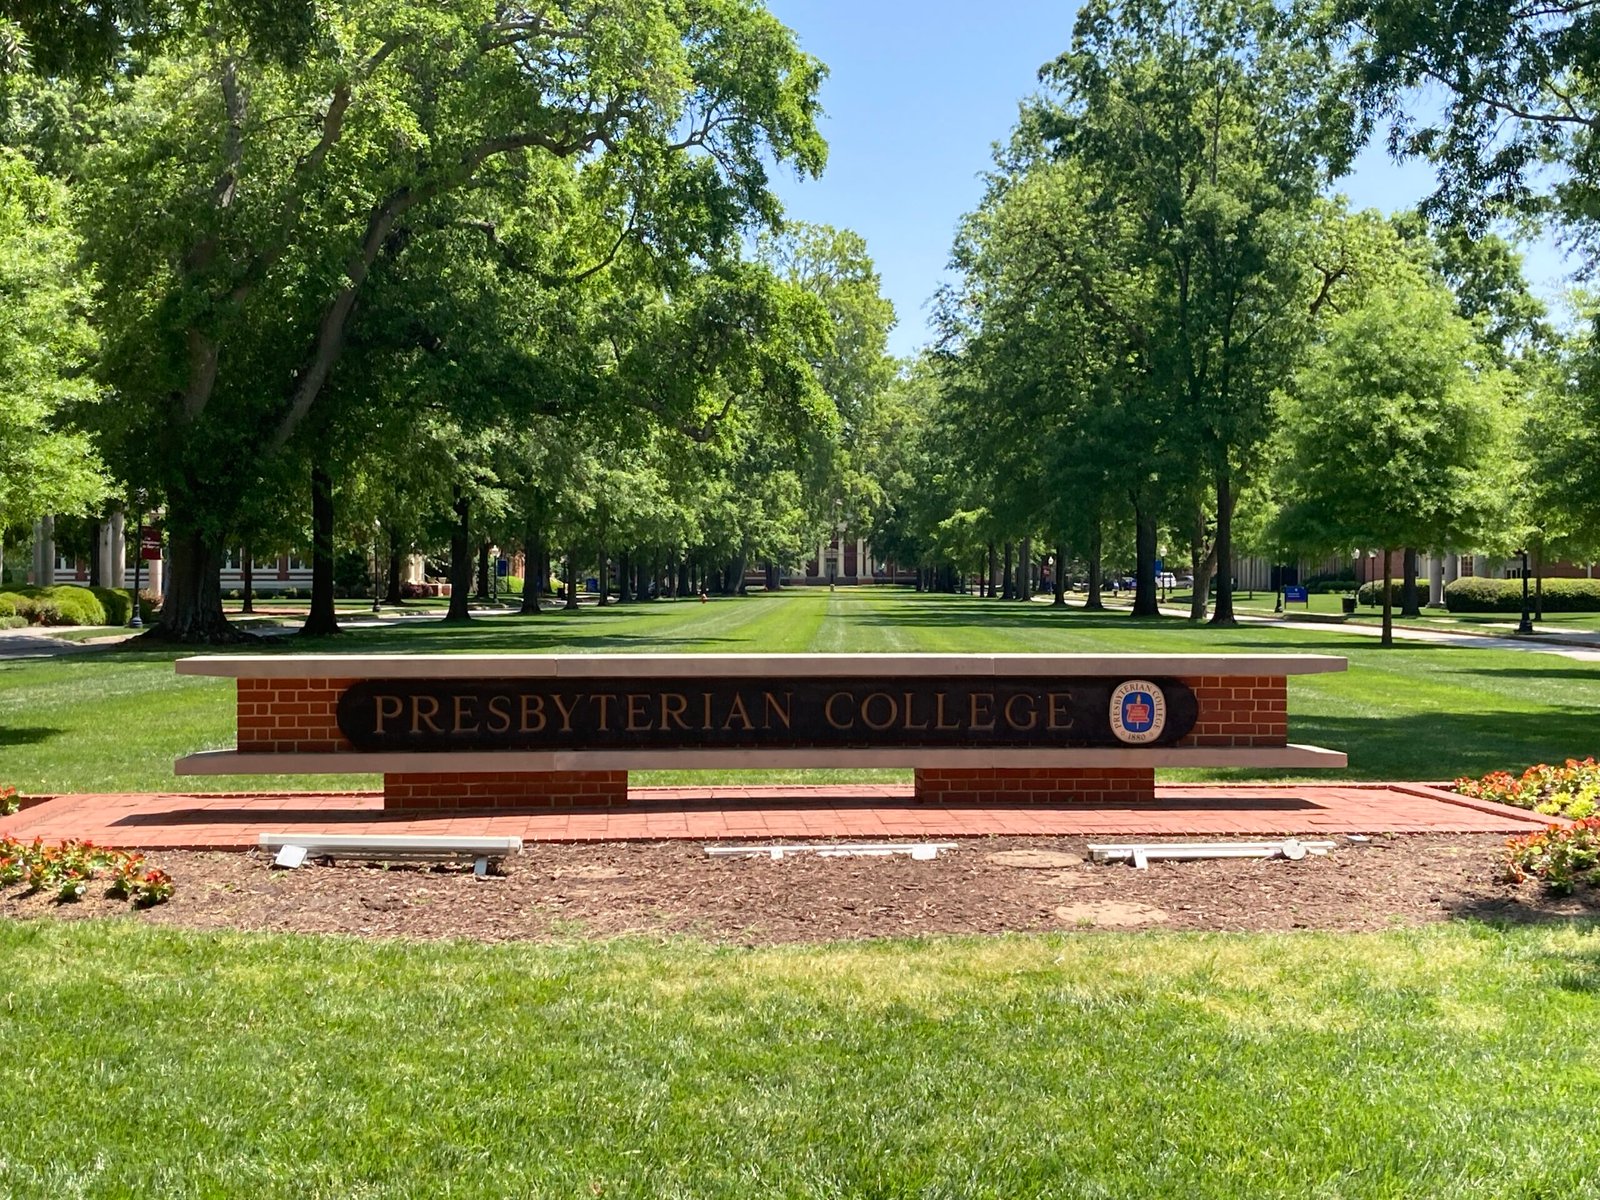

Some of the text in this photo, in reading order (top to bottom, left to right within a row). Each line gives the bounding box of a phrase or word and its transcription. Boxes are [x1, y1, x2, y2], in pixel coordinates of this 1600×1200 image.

[372, 691, 1075, 734] PRESBYTERIAN COLLEGE
[1113, 683, 1164, 729] PRESBYTERIAN COLLEGE
[1128, 733, 1146, 741] 1880
